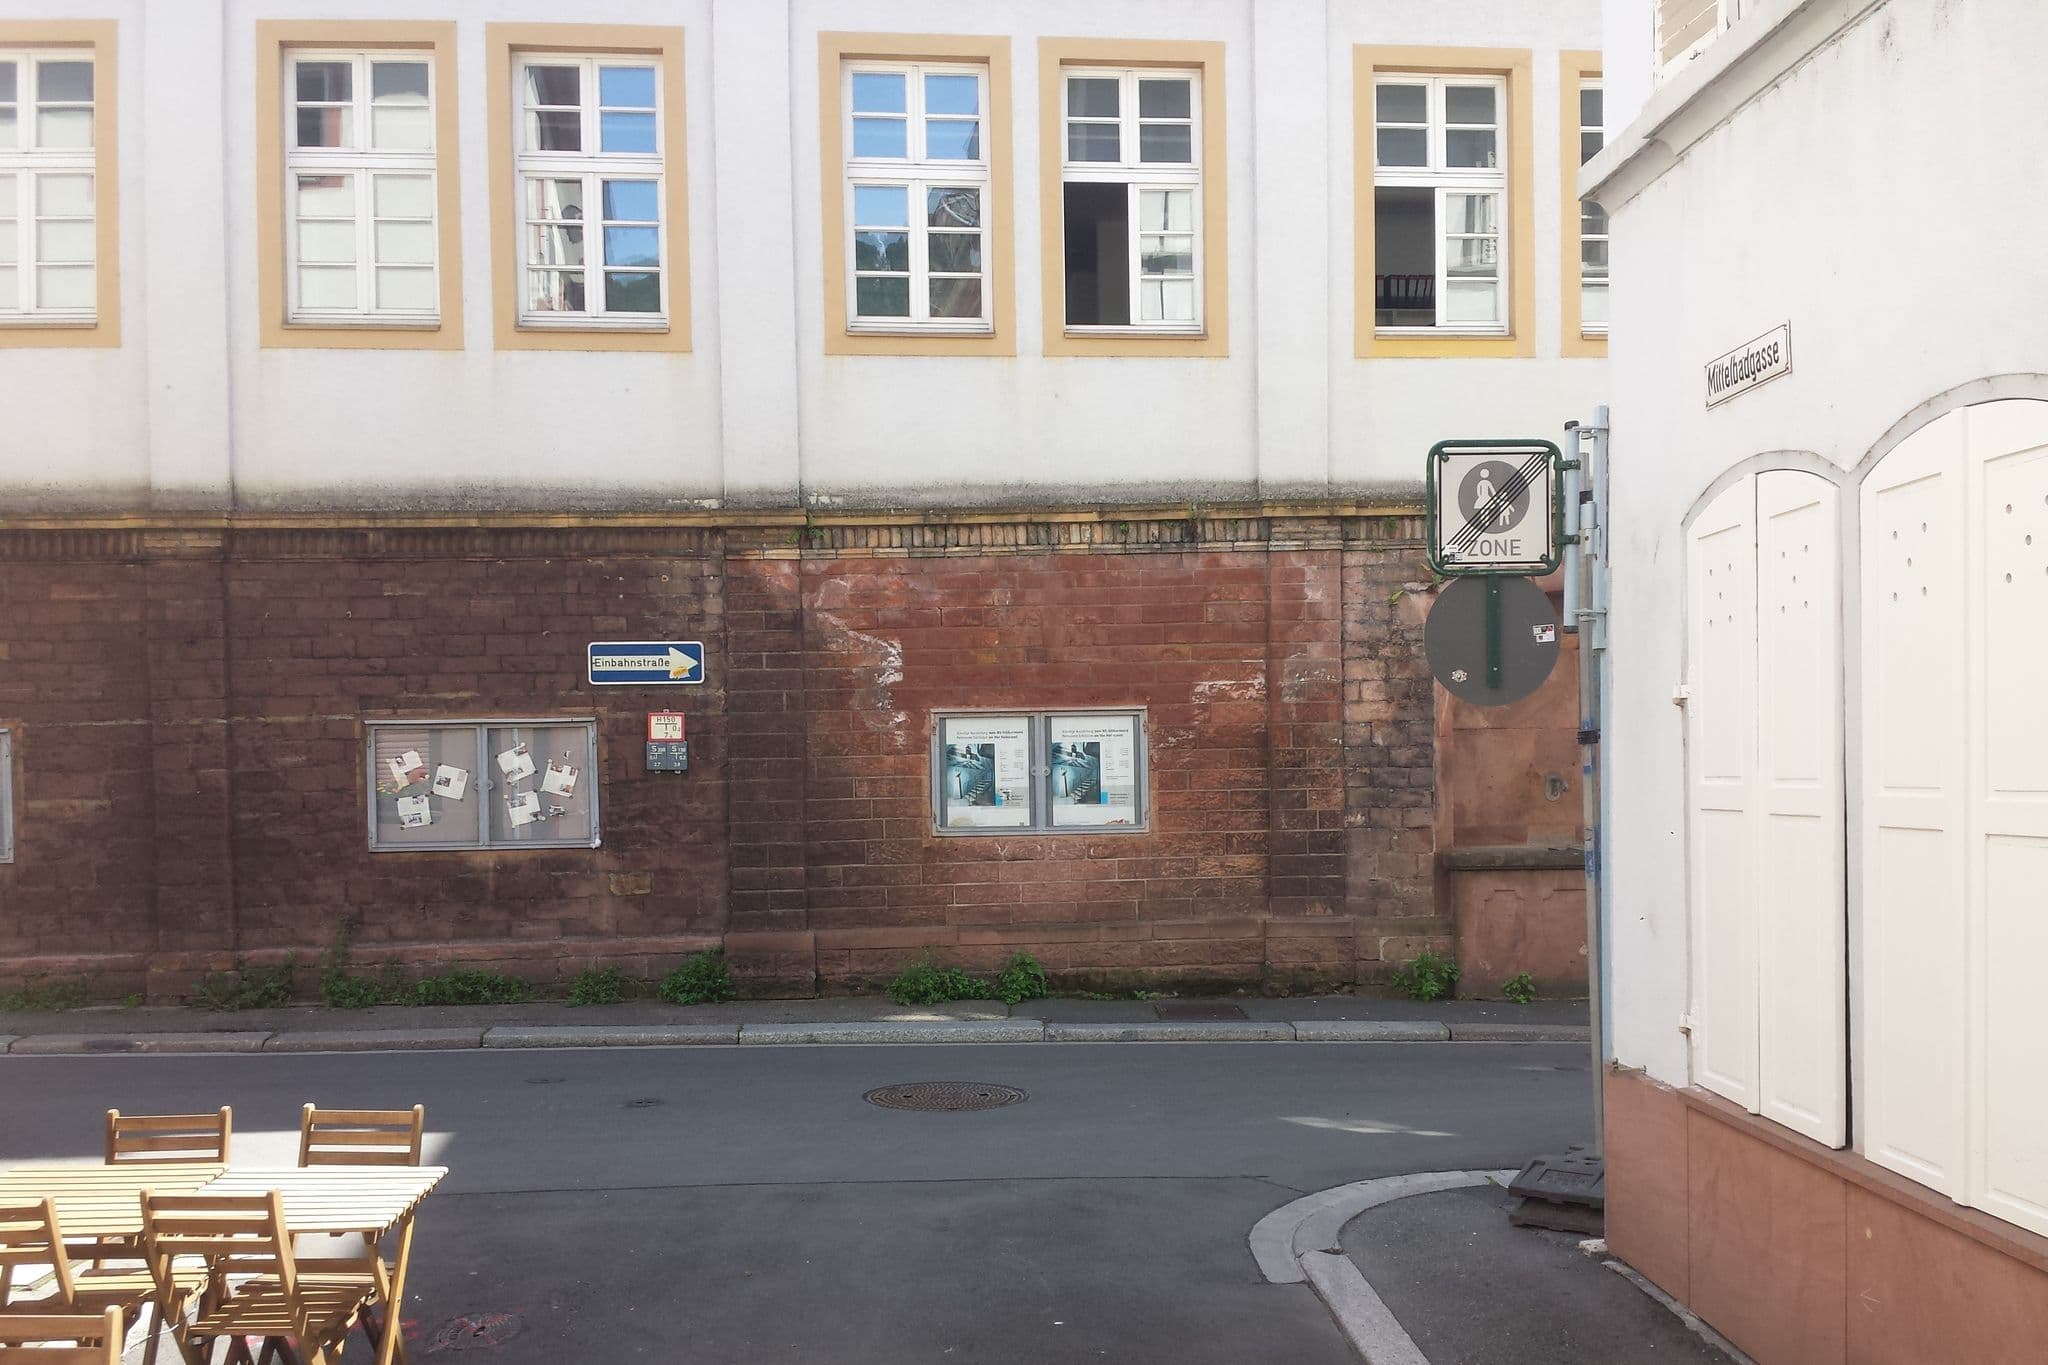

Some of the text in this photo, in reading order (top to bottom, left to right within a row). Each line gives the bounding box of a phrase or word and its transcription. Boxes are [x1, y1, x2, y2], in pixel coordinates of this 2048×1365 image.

[1707, 341, 1779, 396] Mittelbadgasse
[1467, 539, 1521, 556] ZONE
[594, 658, 670, 667] Einbahnstraße
